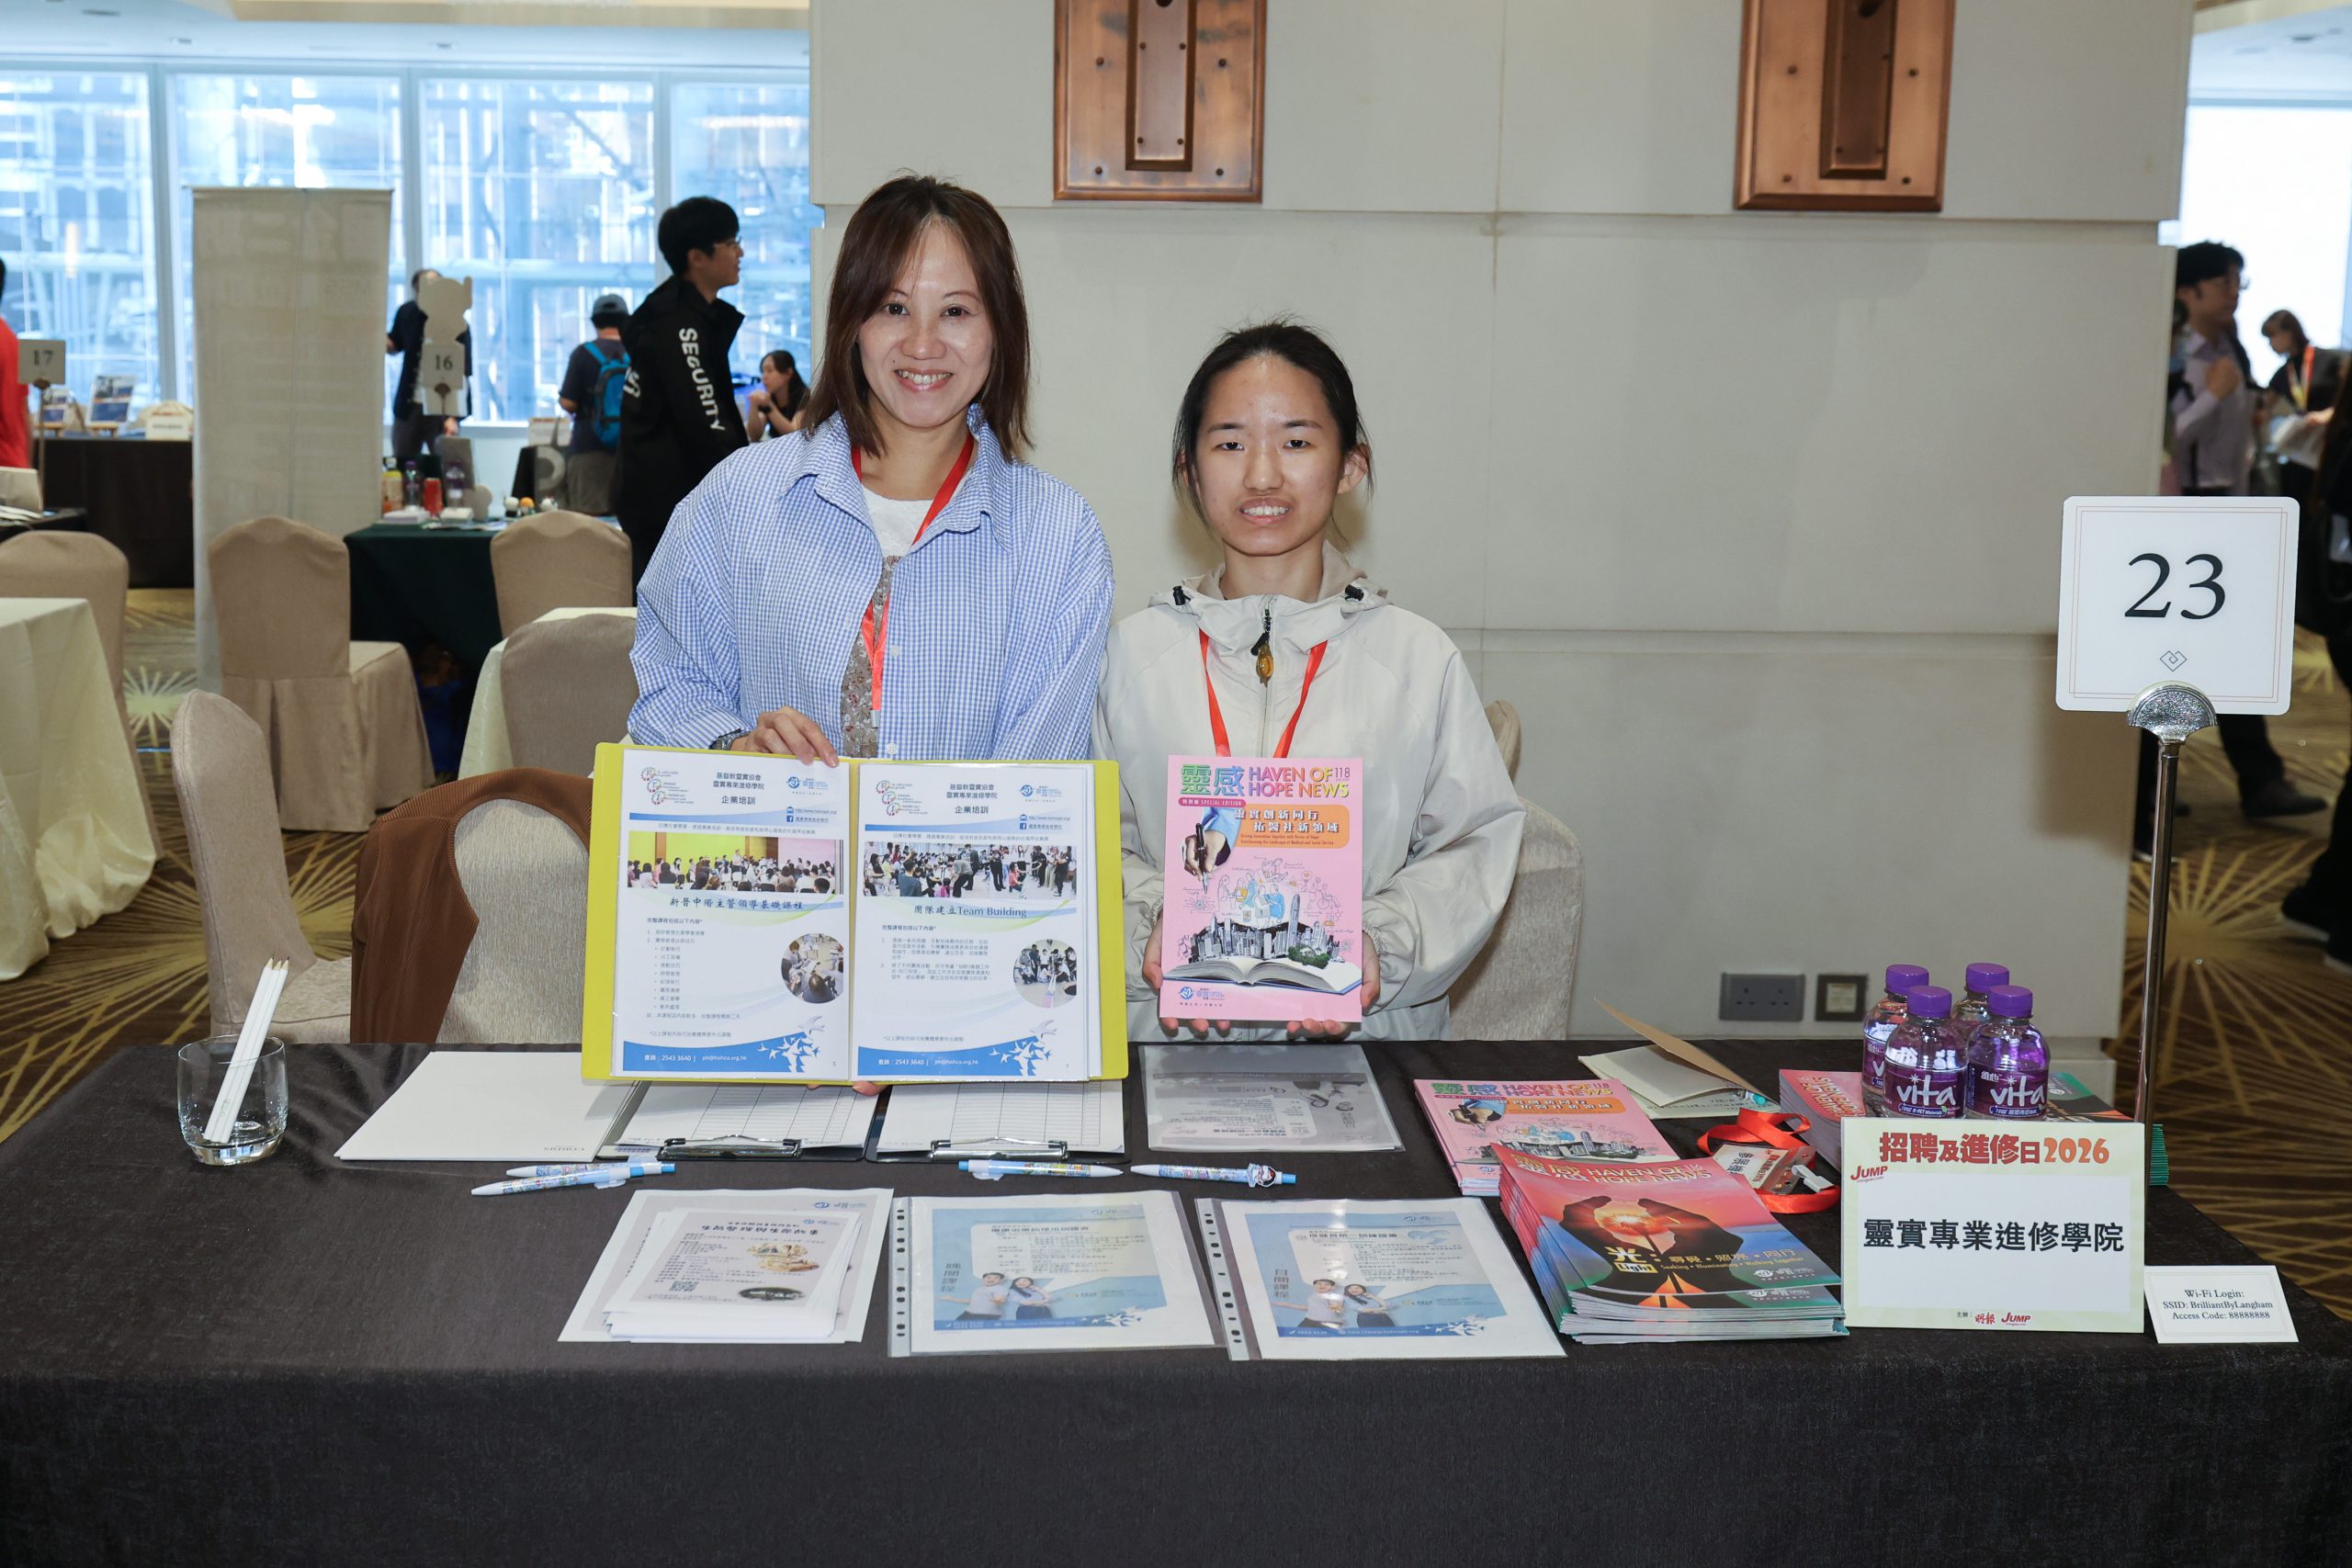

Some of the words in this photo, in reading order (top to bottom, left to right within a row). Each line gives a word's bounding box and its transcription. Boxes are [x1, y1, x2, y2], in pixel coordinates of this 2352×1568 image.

[31, 349, 53, 367] 17
[434, 355, 453, 371] 16
[679, 328, 726, 432] SECURITY
[2124, 553, 2225, 620] 23
[1181, 764, 1245, 796] 靈感
[1249, 767, 1306, 782] HAVEN
[1309, 767, 1333, 783] OF
[1335, 767, 1351, 778] 118
[1249, 782, 1294, 797] HOPE
[1298, 783, 1349, 797] NEWS
[721, 795, 756, 806] 企業培訓
[955, 806, 989, 815] 企業培訓
[987, 907, 1027, 919] Building
[1430, 1083, 1500, 1096] 靈感
[1560, 1089, 1613, 1097] NEWS
[1896, 1074, 1957, 1107] vita
[1990, 1076, 2045, 1107] vita
[1879, 1133, 2109, 1164] 招聘及進修日2026
[1510, 1153, 1590, 1182] 靈感
[1587, 1168, 1654, 1177] HAVEN
[1657, 1166, 1685, 1175] OF
[1849, 1165, 1888, 1180] JUMP
[1593, 1175, 1646, 1183] HOPE
[1653, 1170, 1713, 1182] NEWS
[1863, 1219, 2124, 1252] 靈實專業進修學院
[1763, 1248, 1795, 1258] 同行
[1616, 1263, 1656, 1273] Light
[2184, 1290, 2212, 1298] Wi-Fi
[2214, 1290, 2245, 1300] Login:
[2163, 1301, 2188, 1309] SSID:
[2190, 1301, 2274, 1310] BrilliantByLangham
[1974, 1313, 1996, 1325] 明報
[2001, 1312, 2031, 1323] JUMP
[2172, 1312, 2200, 1320] Access
[2201, 1312, 2227, 1320] Code:
